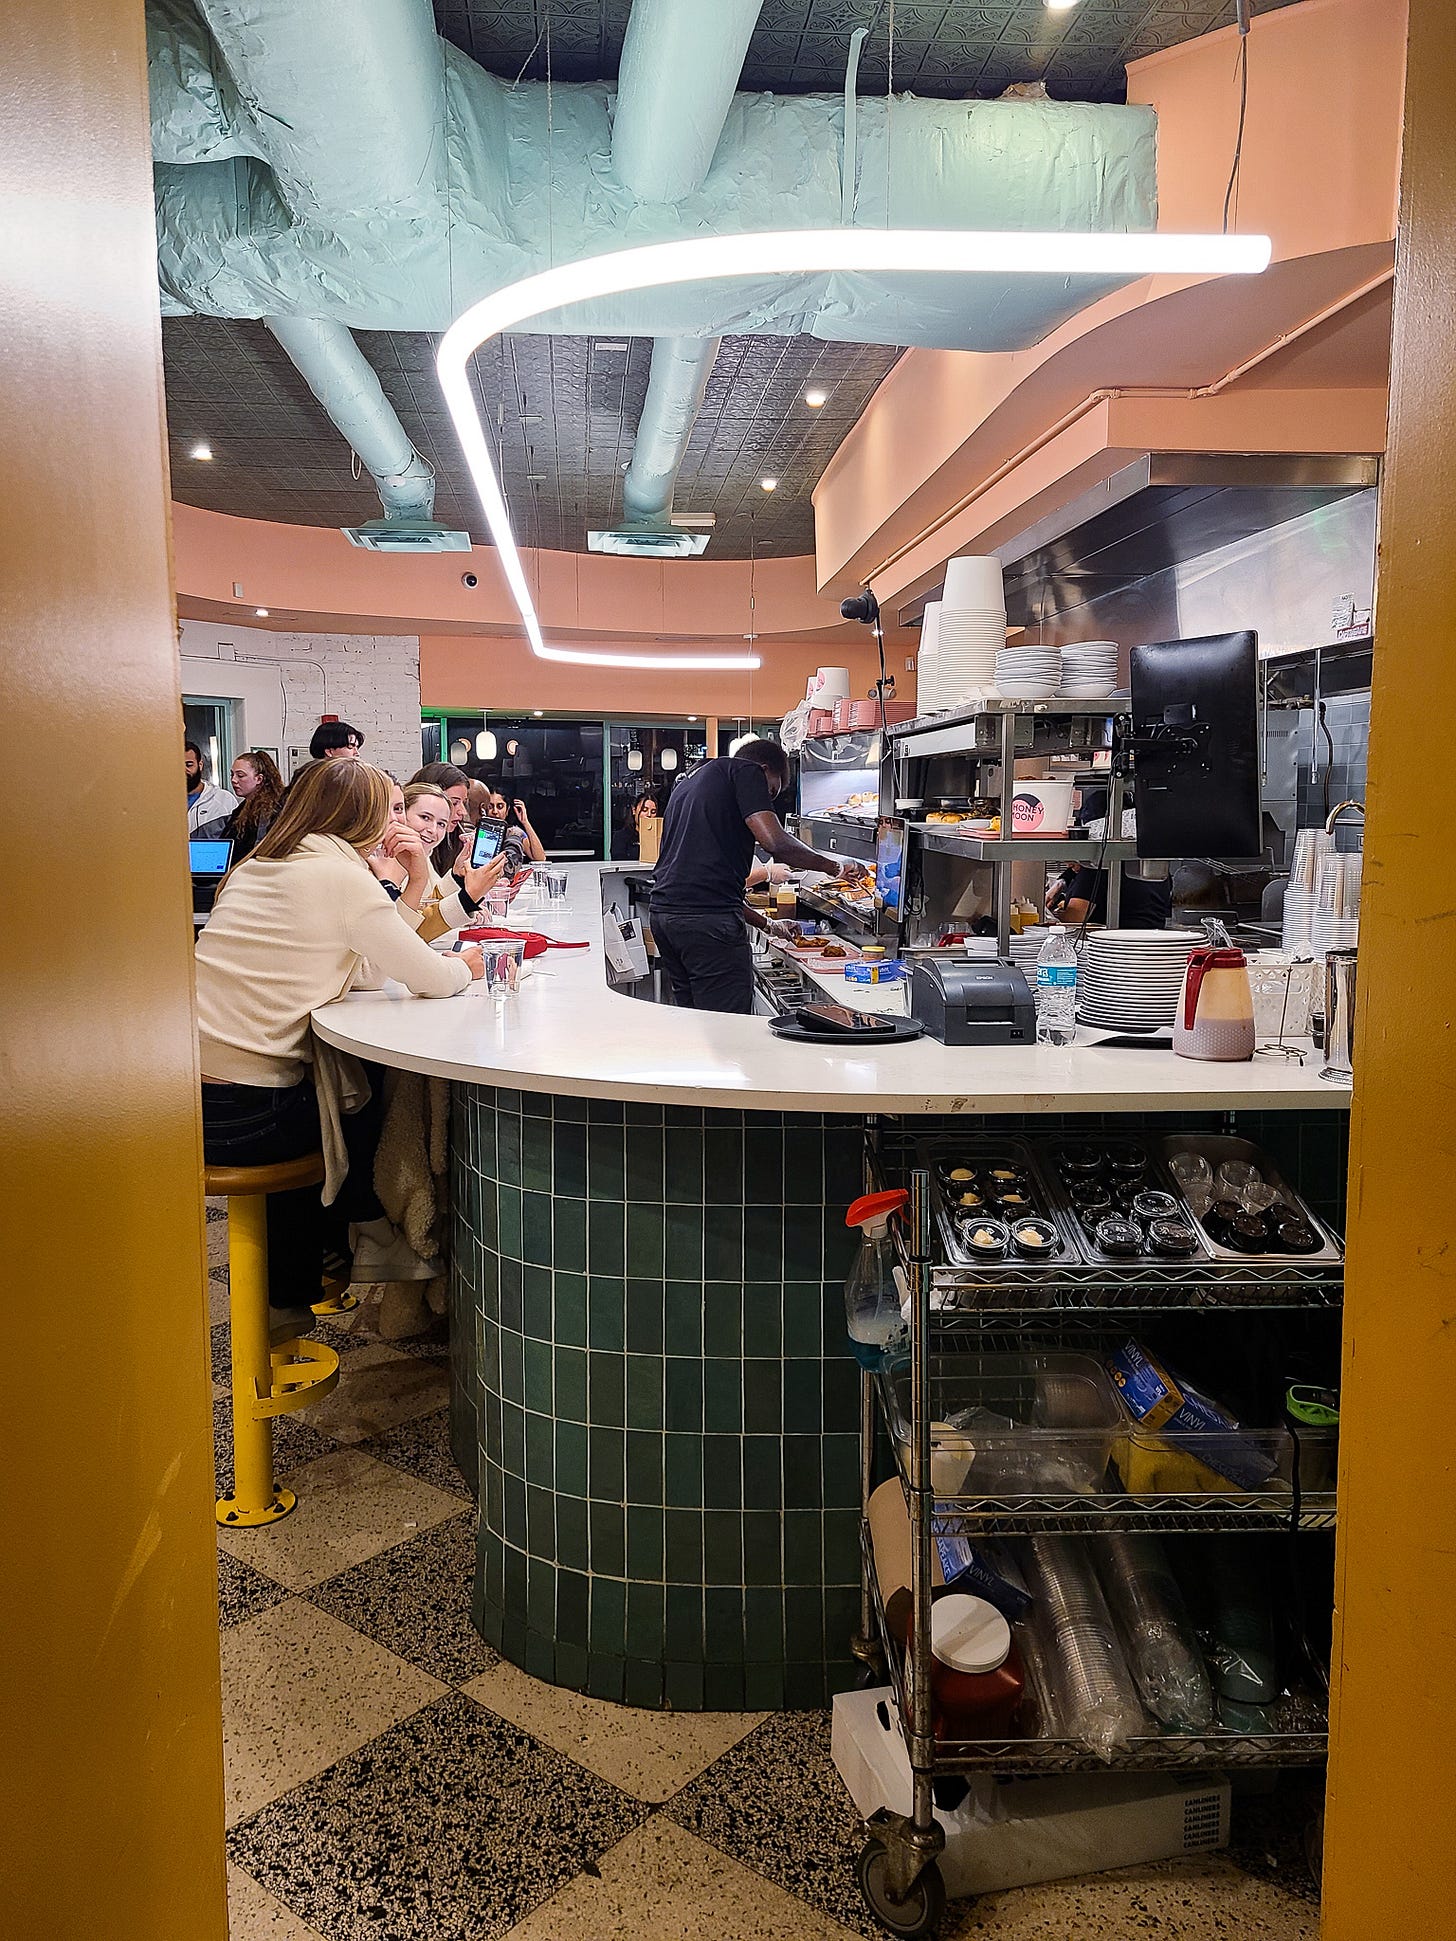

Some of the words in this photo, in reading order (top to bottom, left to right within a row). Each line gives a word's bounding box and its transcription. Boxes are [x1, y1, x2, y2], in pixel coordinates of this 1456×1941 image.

[1012, 812, 1035, 821] OON
[1124, 1338, 1144, 1367] VINYL
[969, 1565, 995, 1587] VINYL
